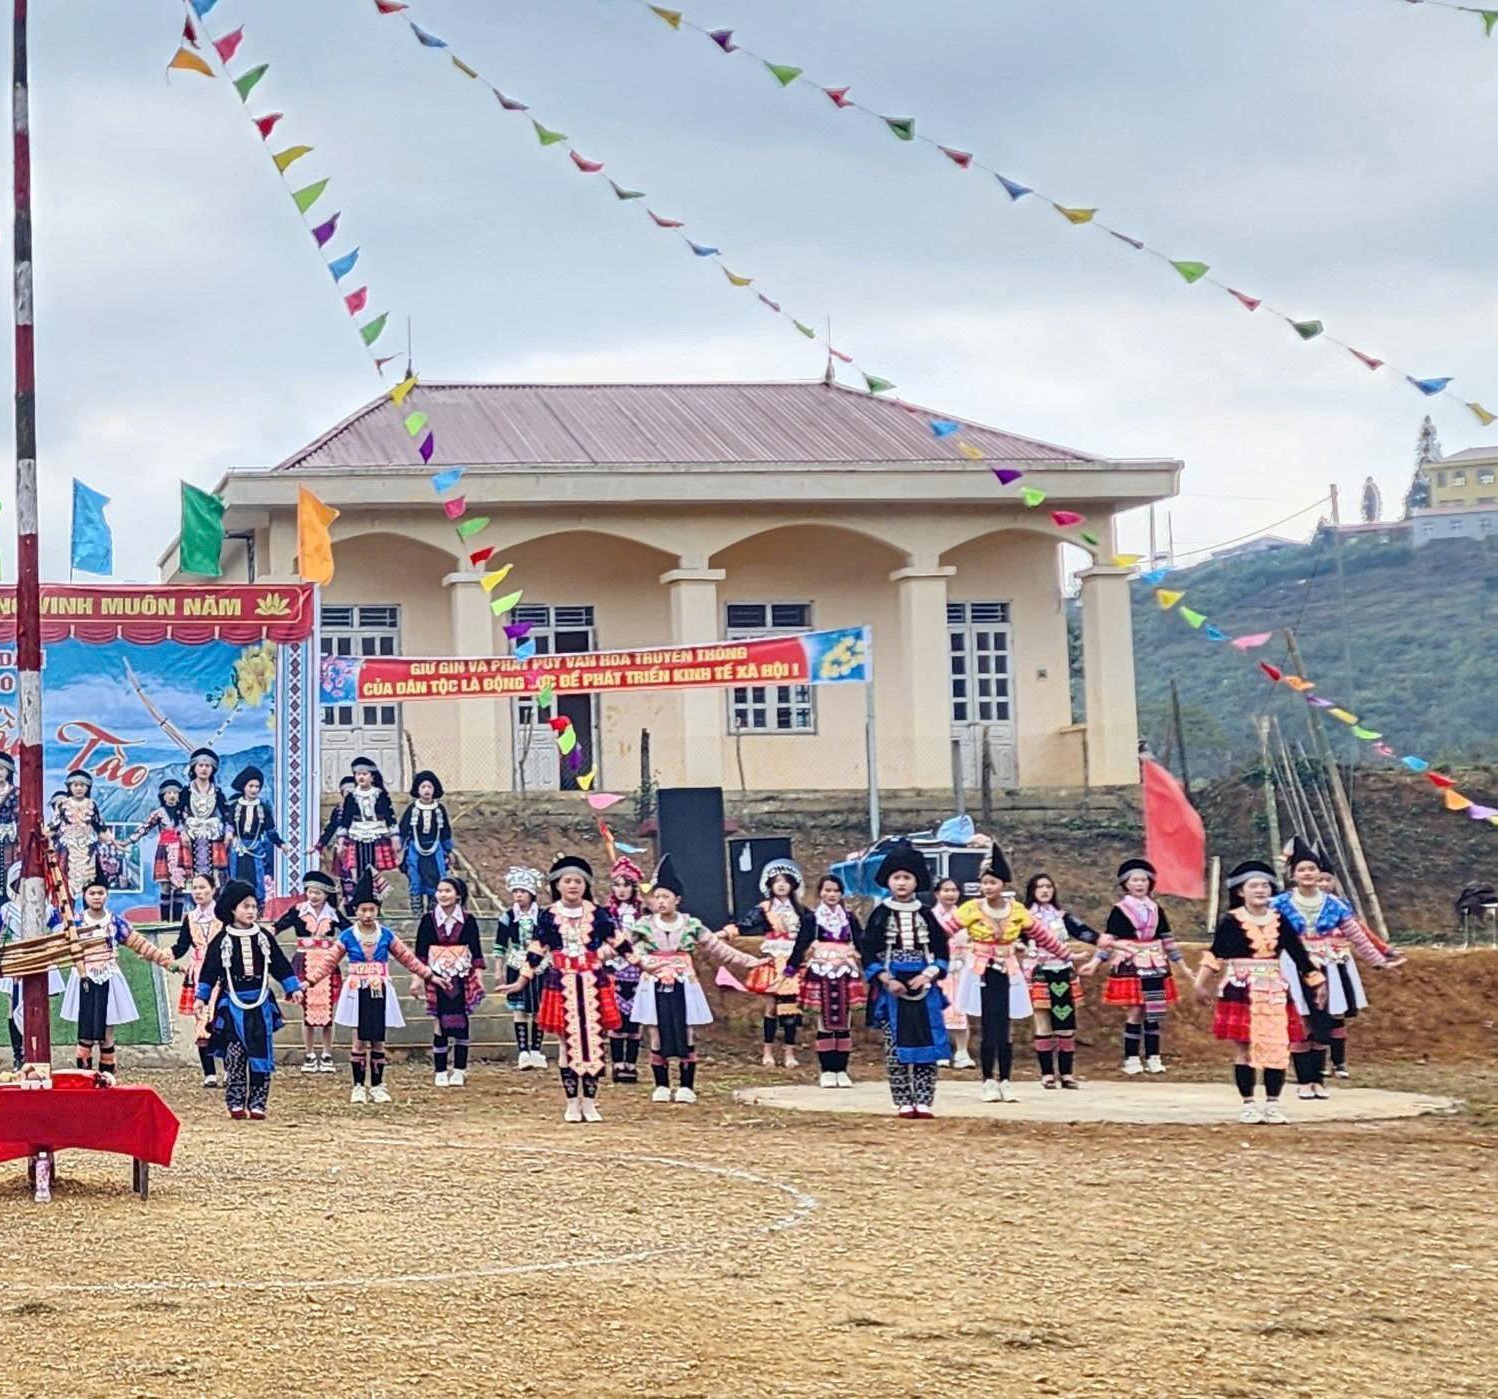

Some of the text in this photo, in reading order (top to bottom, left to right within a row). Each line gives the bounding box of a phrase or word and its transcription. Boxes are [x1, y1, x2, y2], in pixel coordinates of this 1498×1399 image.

[39, 596, 93, 615] VINH
[101, 593, 175, 616] MUÔN
[183, 593, 241, 616] NĂM
[673, 667, 712, 683] KINH
